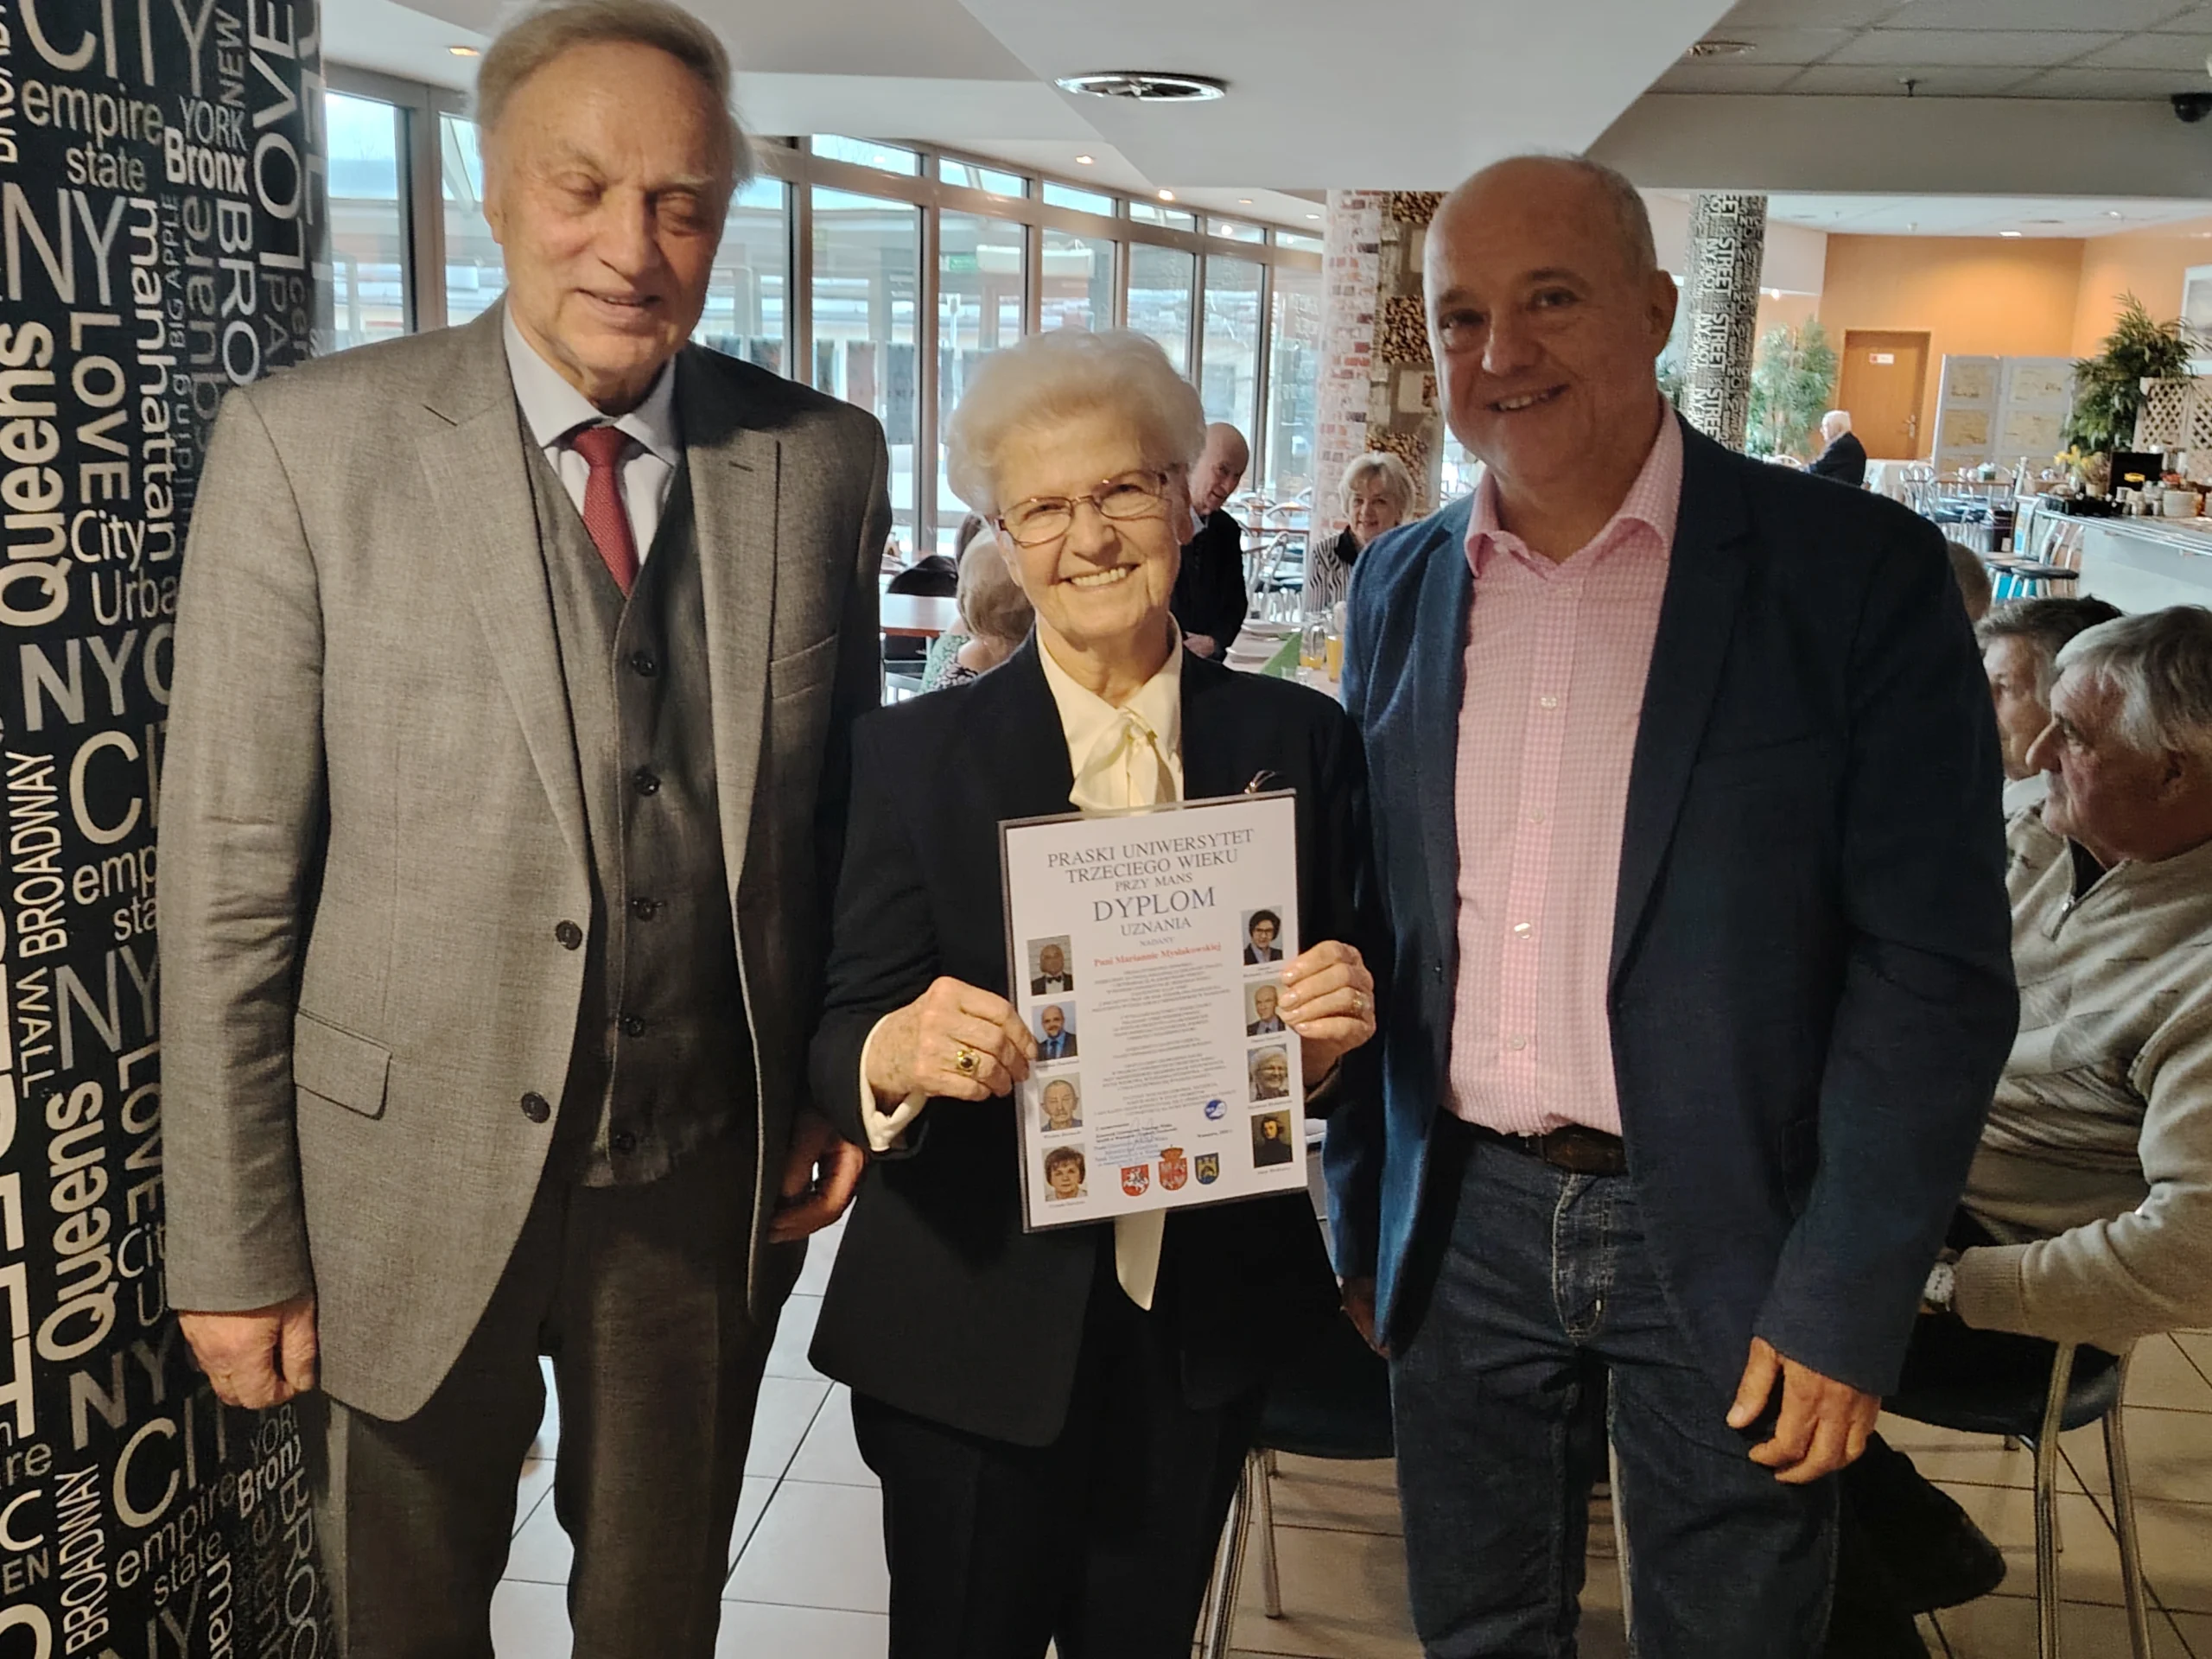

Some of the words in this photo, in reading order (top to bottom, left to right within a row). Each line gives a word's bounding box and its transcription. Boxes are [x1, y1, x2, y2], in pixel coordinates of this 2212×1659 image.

[216, 8, 245, 108] NEW
[22, 79, 164, 149] empire
[180, 96, 248, 150] YORK
[248, 1, 305, 270] LOVE
[66, 141, 149, 193] state
[163, 126, 249, 195] Bronx
[3, 181, 129, 306] NY
[1715, 236, 1736, 298] STREET
[130, 198, 178, 562] manhattan
[1708, 314, 1730, 372] STREET
[69, 310, 130, 504] LOVE
[0, 321, 73, 626] Queens
[71, 509, 145, 571] City
[5, 751, 67, 958] BROADWAY
[1047, 848, 1115, 868] PRASKI
[1123, 829, 1254, 859] UNIWERSYTET
[1065, 858, 1172, 884] TRZECIEGO
[1178, 849, 1239, 869] WIEKU
[1116, 880, 1149, 893] PRZY
[1154, 873, 1193, 887] MANS
[1093, 887, 1216, 922] DYPLOM
[1121, 917, 1192, 937] UZNANIA
[16, 967, 55, 1098] WALL
[55, 945, 159, 1071] NY
[36, 1080, 119, 1362] Queens
[54, 1464, 110, 1656] BROADWAY
[116, 1469, 236, 1588] empire
[154, 1531, 223, 1606] state
